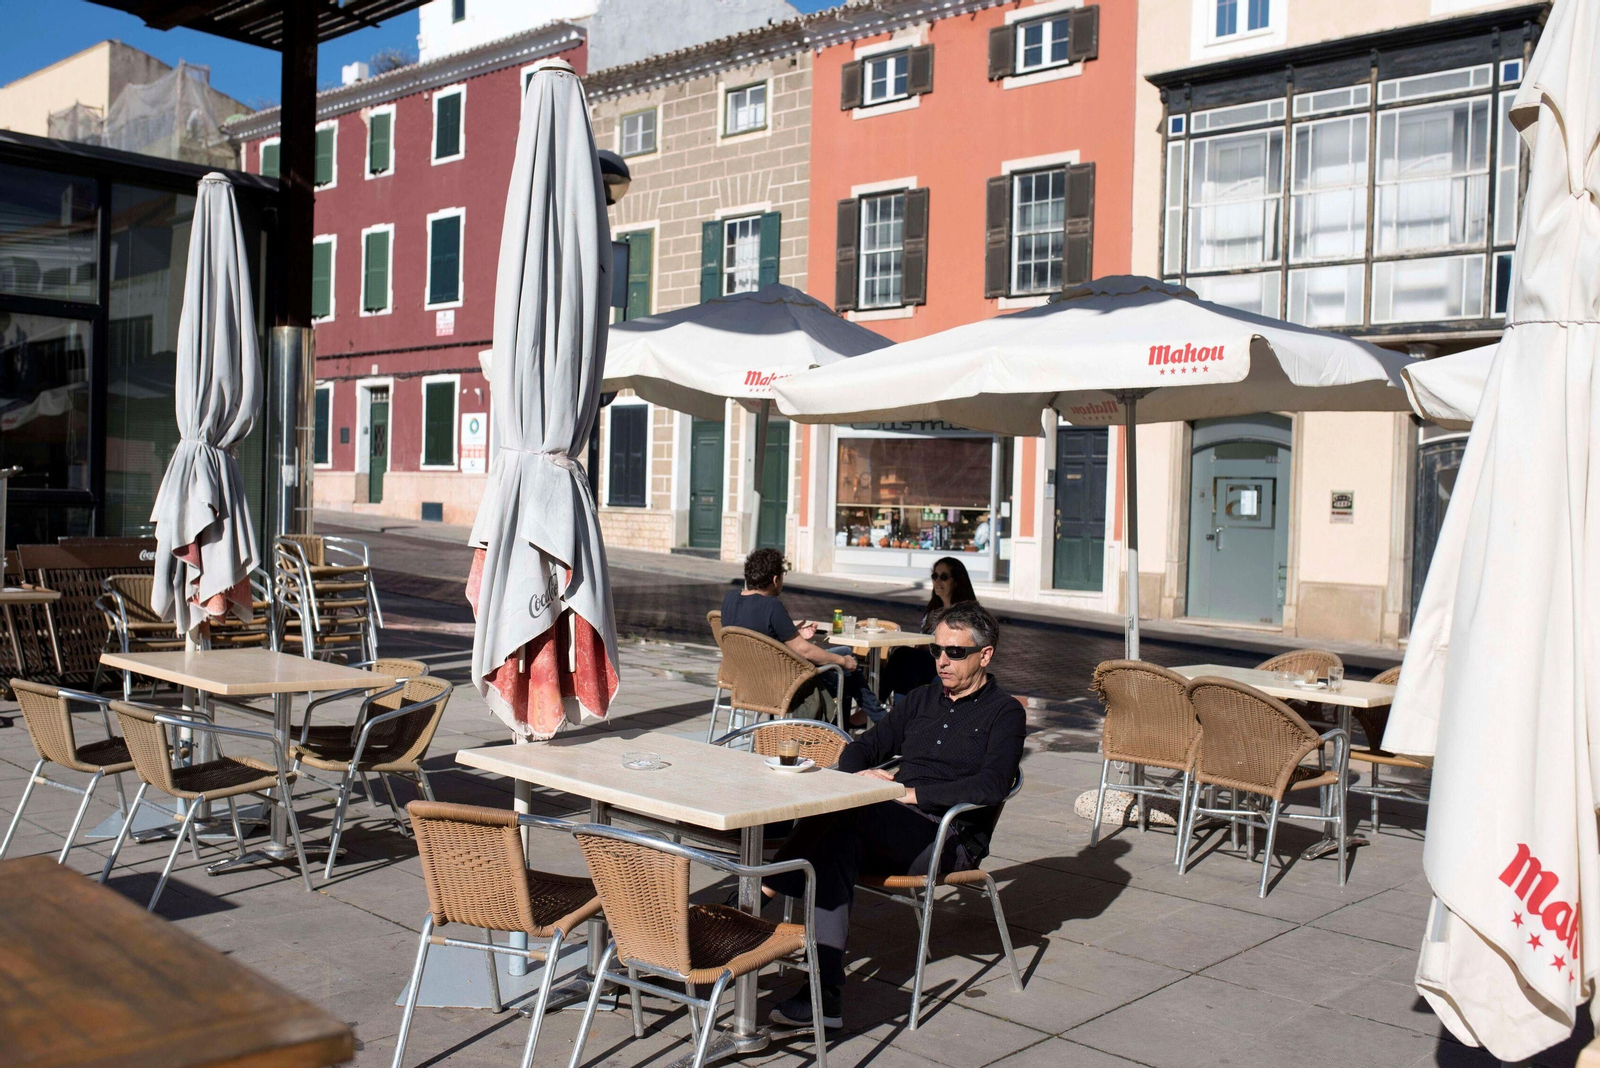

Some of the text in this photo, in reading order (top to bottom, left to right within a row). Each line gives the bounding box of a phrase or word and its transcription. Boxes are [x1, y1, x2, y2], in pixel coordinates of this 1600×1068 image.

[1148, 342, 1225, 366] Mahou
[744, 370, 793, 386] Mah
[1498, 843, 1579, 960] Mah
